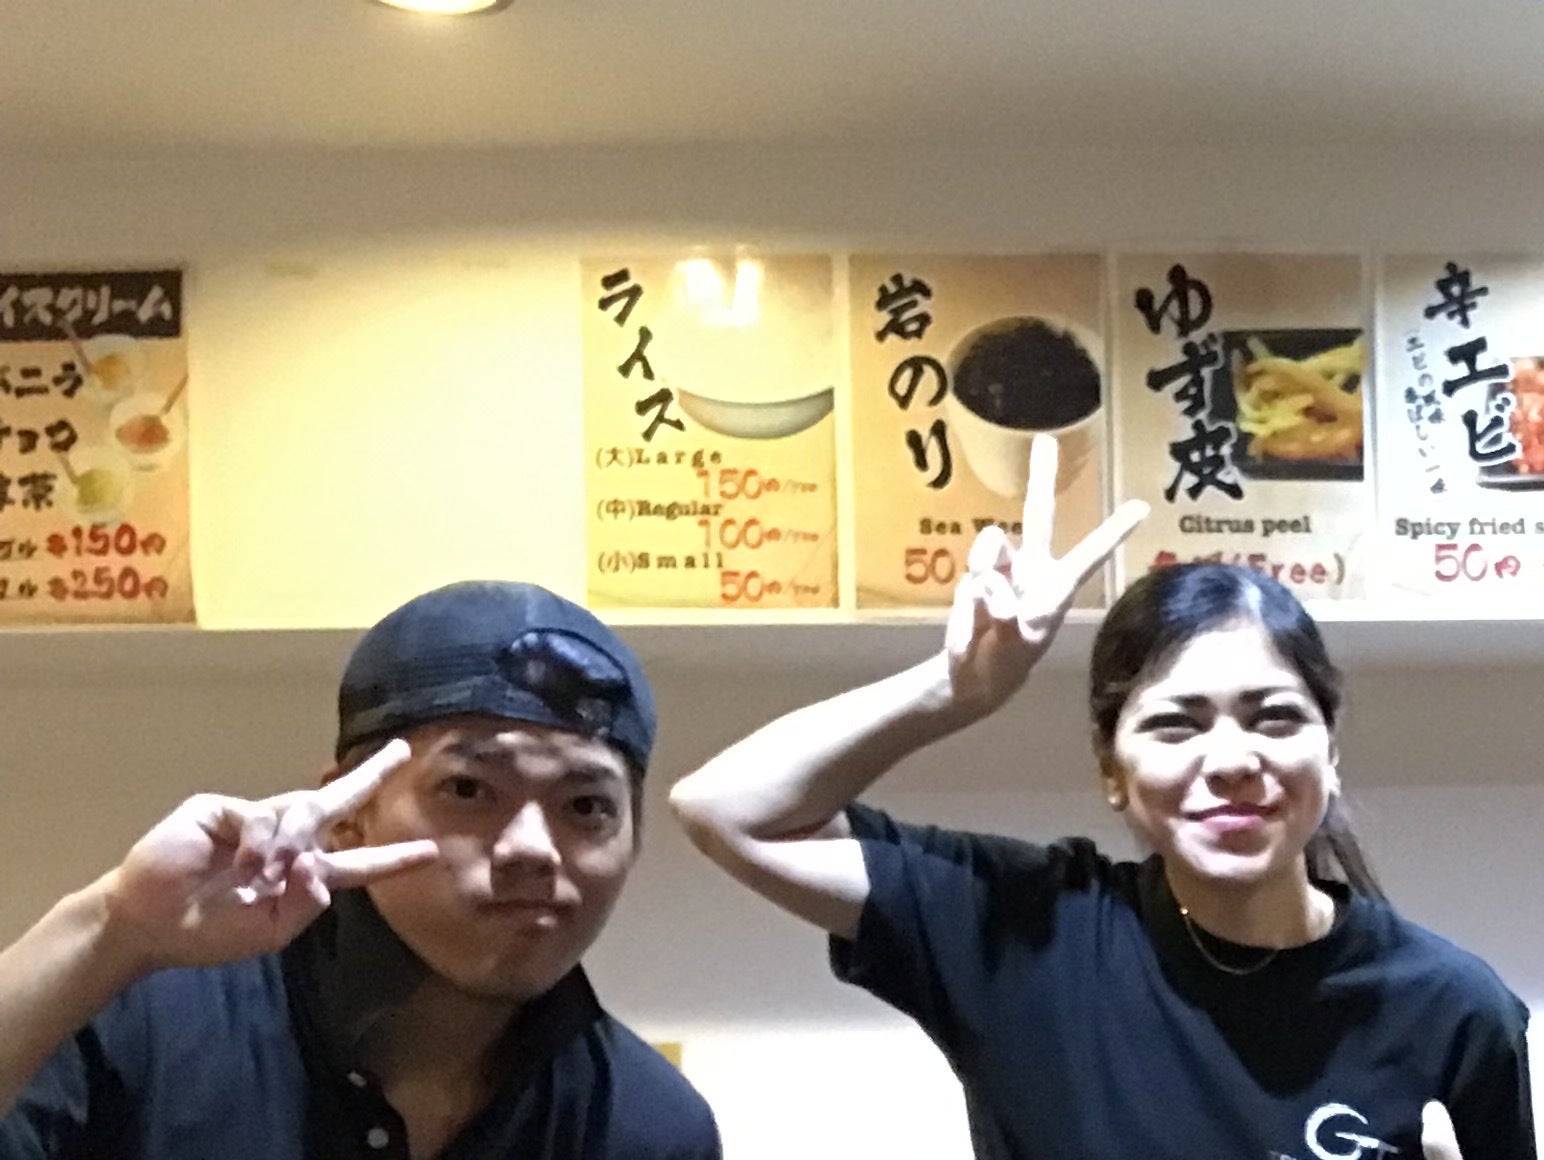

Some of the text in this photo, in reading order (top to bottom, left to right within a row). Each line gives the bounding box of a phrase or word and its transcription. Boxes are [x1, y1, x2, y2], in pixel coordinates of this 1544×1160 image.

[598, 267, 686, 442] ライス
[874, 272, 952, 490] 岩のり
[1135, 263, 1244, 503] ゆず皮
[920, 518, 962, 534] Sea
[1179, 515, 1312, 537] Citrus peel
[1395, 517, 1460, 540] Spicy
[1469, 517, 1525, 535] fried
